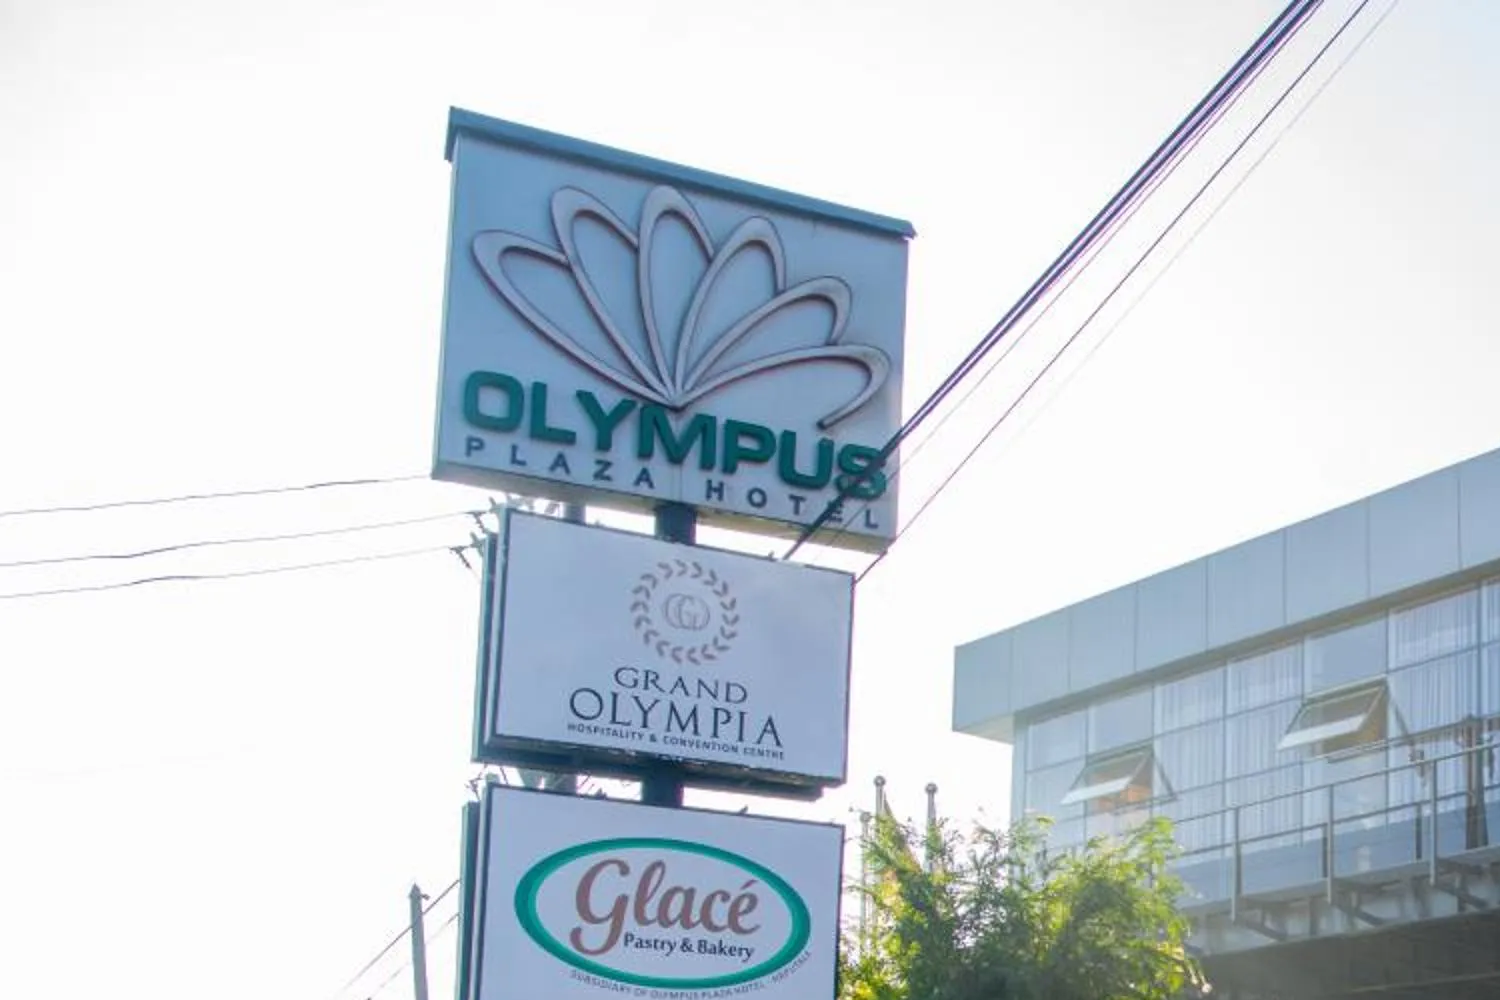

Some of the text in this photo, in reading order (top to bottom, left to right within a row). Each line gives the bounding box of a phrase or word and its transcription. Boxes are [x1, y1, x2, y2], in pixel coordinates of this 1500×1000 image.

[463, 370, 887, 501] OLYMPUS
[465, 435, 879, 530] PLAZA HOTEL
[614, 667, 748, 704] GRAND
[567, 723, 785, 760] HOSPITALITY & CONVENTION CENTRE
[569, 687, 783, 748] OLYMPIA
[569, 858, 762, 956] Glacé
[623, 932, 756, 963] Pastry & Bakery
[701, 987, 734, 1000] PLAZA
